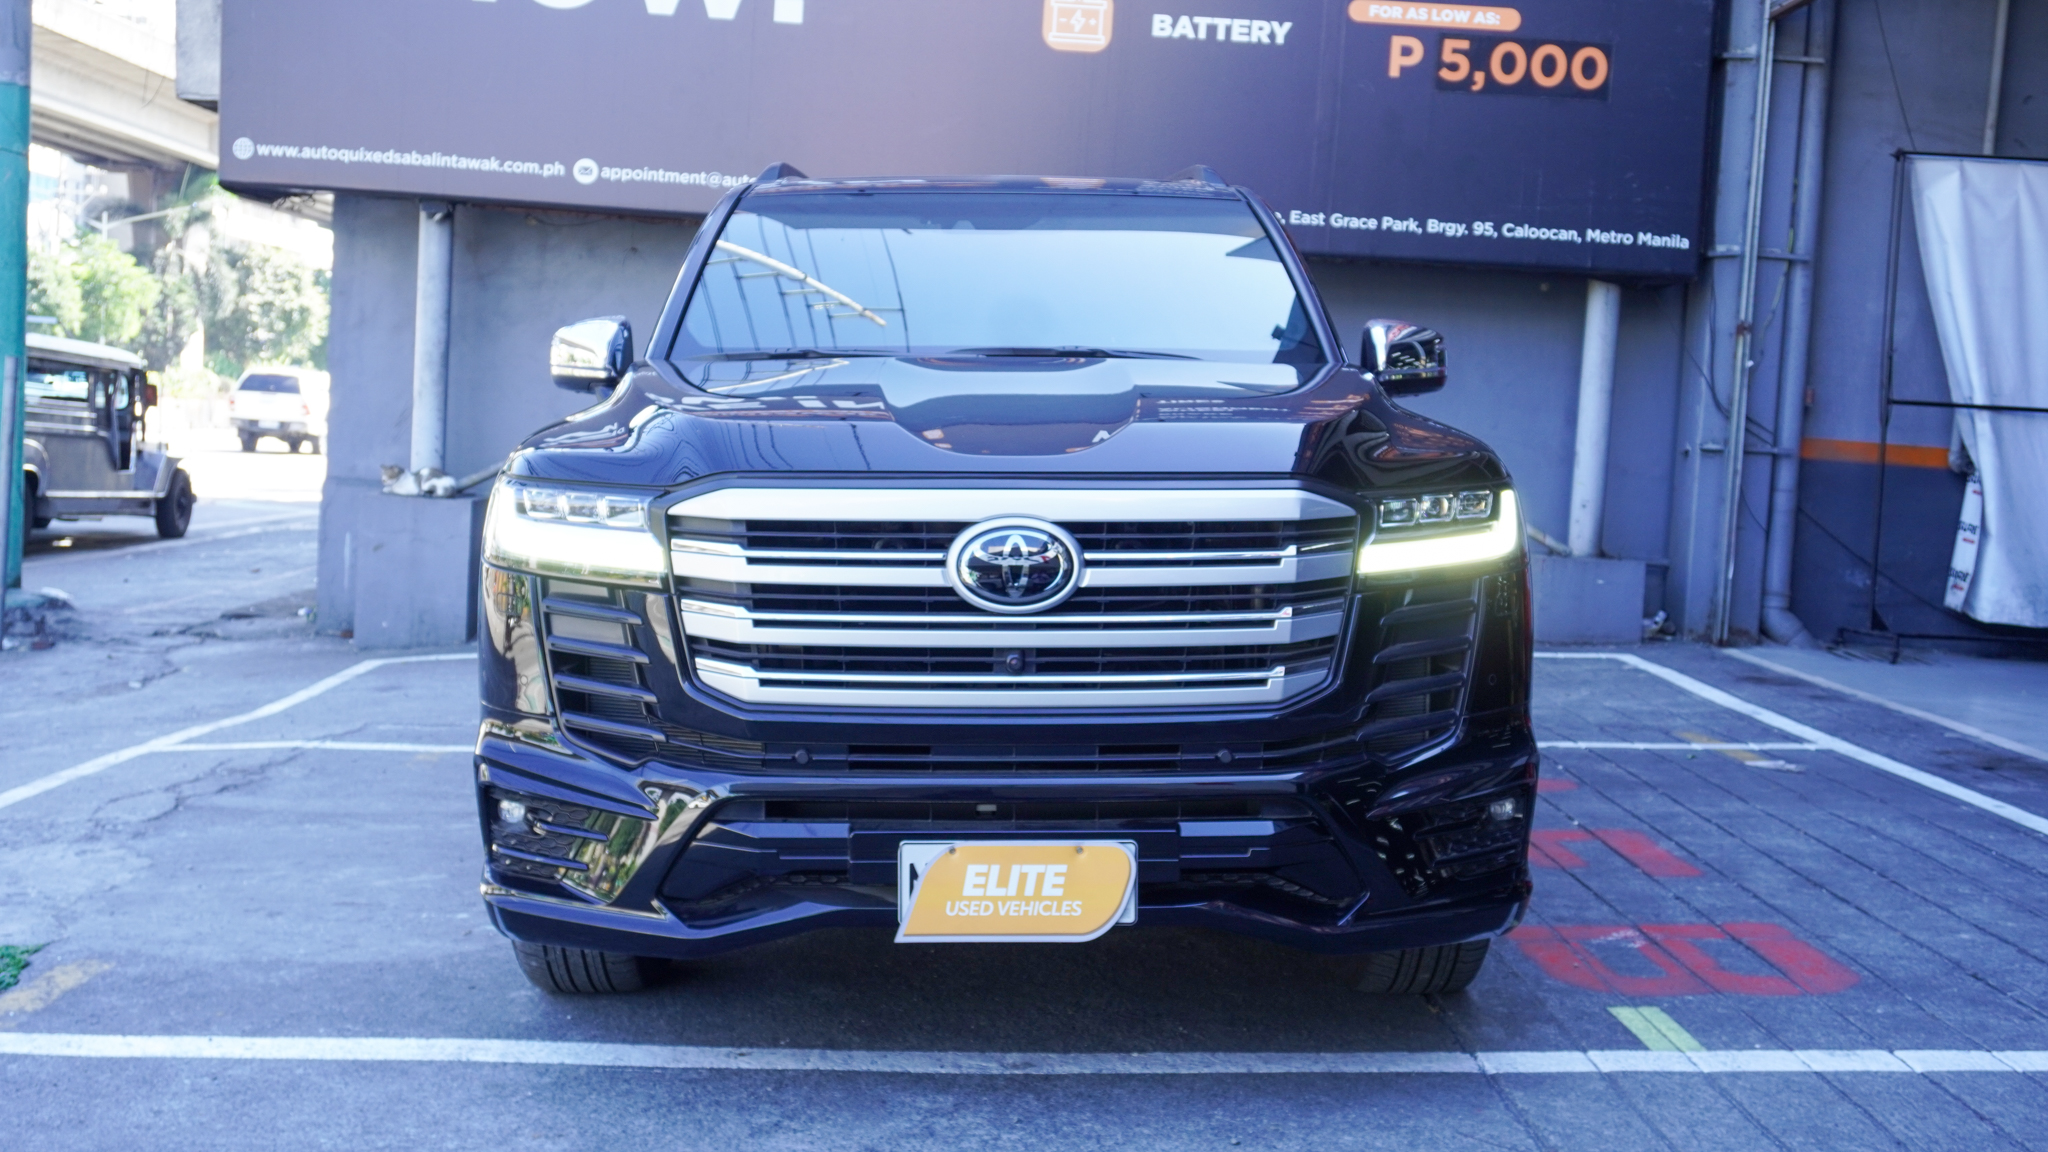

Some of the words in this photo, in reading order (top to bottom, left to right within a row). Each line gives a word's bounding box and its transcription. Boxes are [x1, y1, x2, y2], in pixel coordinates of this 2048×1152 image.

[1151, 13, 1293, 45] BATTERY
[1369, 4, 1402, 19] FOR
[1405, 8, 1429, 21] AS
[1431, 9, 1471, 24] LOW
[1473, 12, 1501, 25] AS:
[1388, 35, 1424, 78] P
[1438, 38, 1608, 91] 5,000
[256, 143, 565, 177] www.autoquixedsabalintawak.com.ph
[1289, 210, 1326, 226] East
[1330, 213, 1378, 229] Grace
[1381, 216, 1422, 235] Park,
[1426, 218, 1469, 237] Brgy.
[1472, 221, 1498, 239] 95,
[1502, 222, 1582, 244] Caloocan,
[1585, 228, 1634, 245] Metro
[1637, 231, 1690, 249] Manila
[962, 864, 1068, 897] ELITE
[945, 900, 994, 917] USED
[998, 900, 1082, 917] VEHICLES
